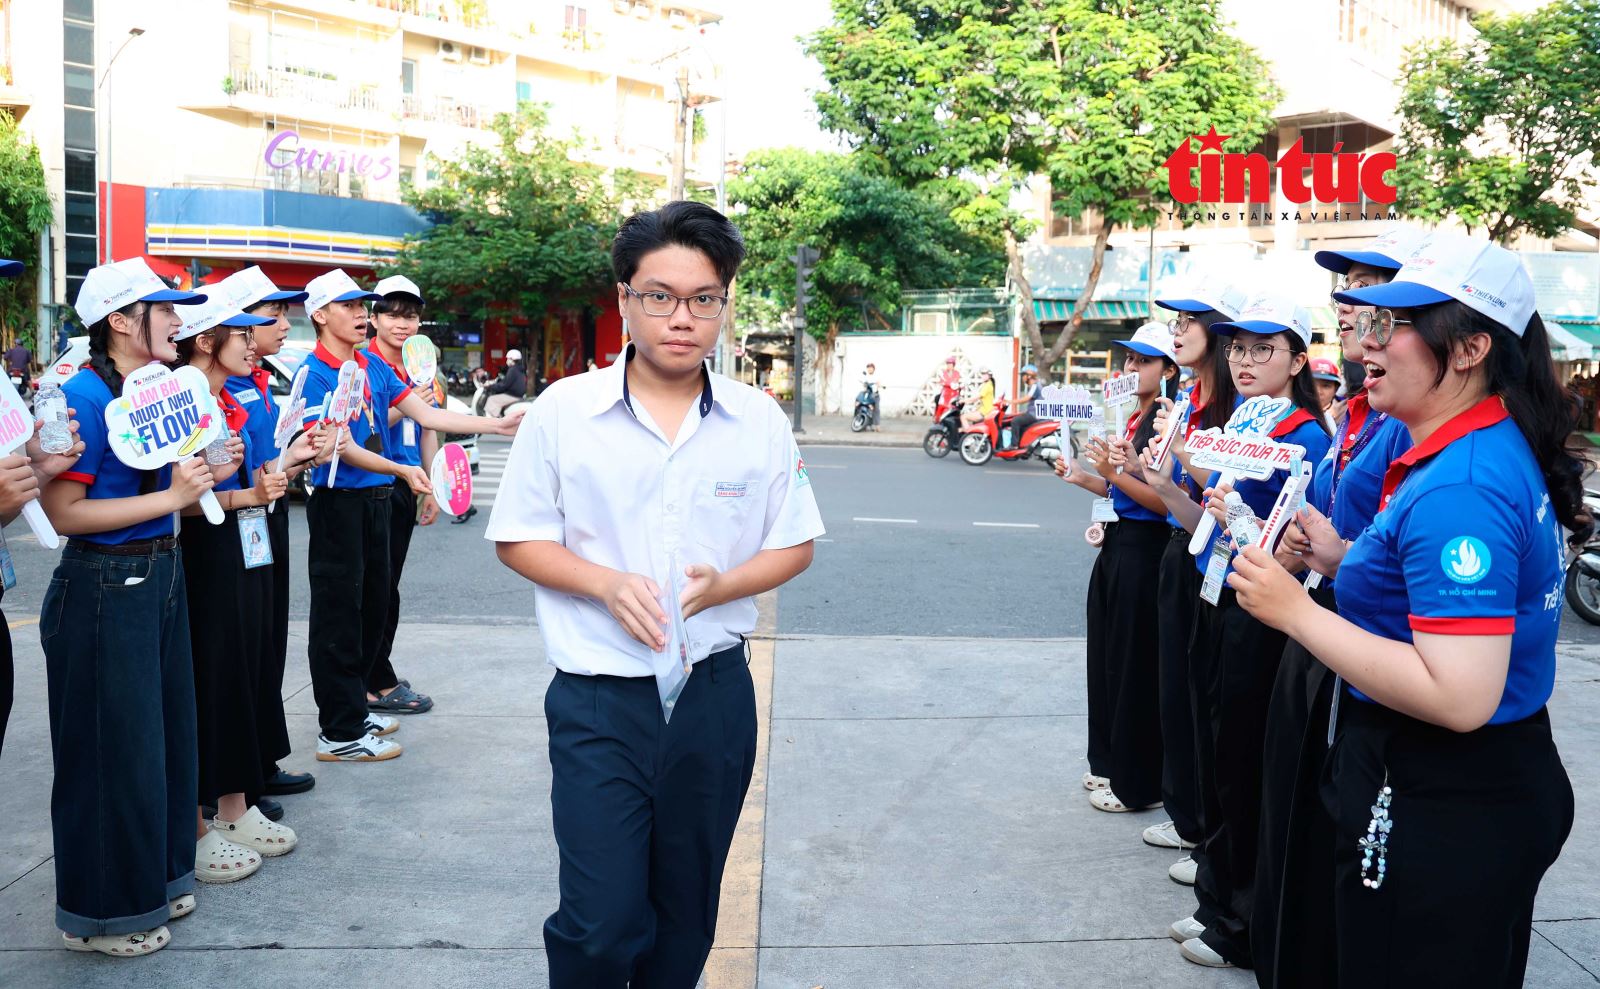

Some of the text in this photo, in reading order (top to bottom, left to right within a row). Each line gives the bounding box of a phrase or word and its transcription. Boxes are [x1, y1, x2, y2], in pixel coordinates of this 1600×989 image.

[1036, 403, 1048, 417] THI
[137, 405, 200, 455] FLOW
[1188, 432, 1214, 449] TIẾP
[1449, 587, 1460, 597] HỒ
[1461, 588, 1476, 597] CHÍ
